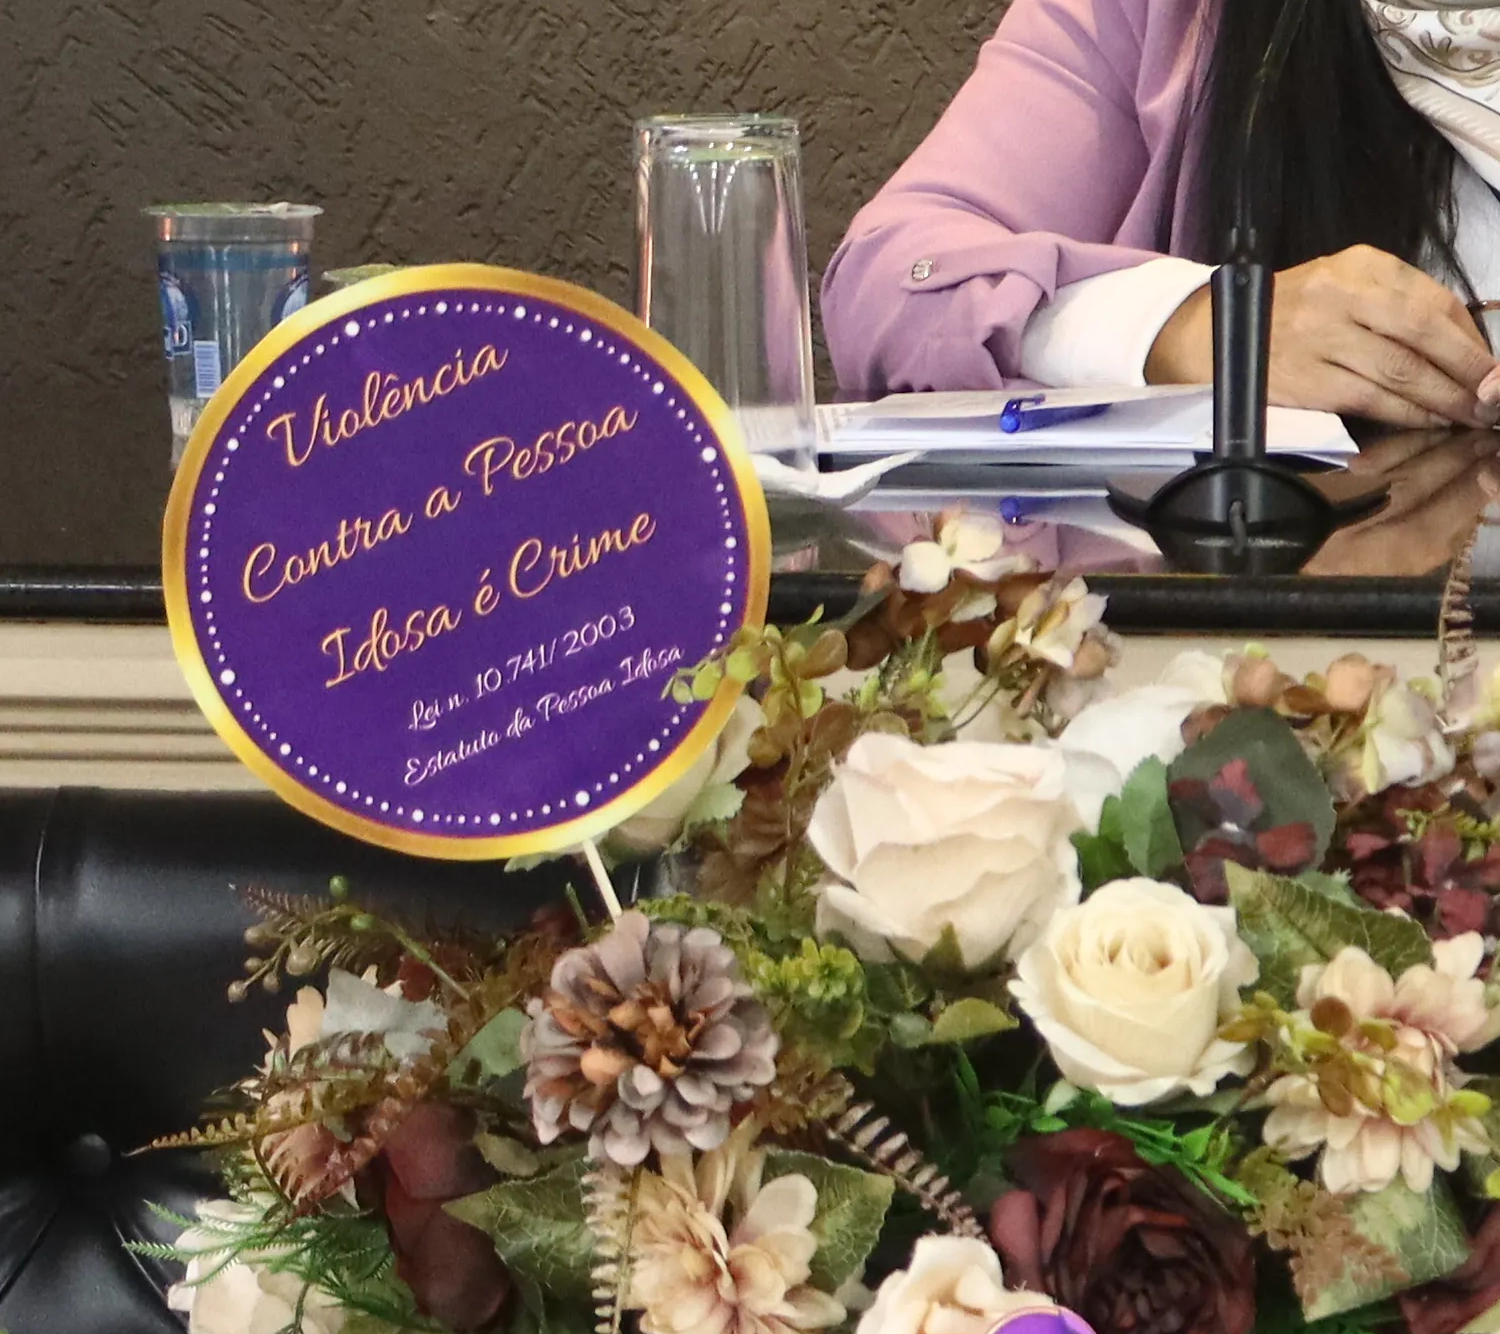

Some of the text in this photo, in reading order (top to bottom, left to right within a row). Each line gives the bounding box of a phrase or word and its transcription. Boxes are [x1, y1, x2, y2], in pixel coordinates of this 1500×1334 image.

[267, 344, 509, 468] Violência
[242, 405, 639, 603] Contra a Pessoa
[322, 511, 658, 688] Idosa é Crime
[403, 646, 687, 786] Estatuto da Pessoa Idosa
[408, 698, 444, 732] Lei
